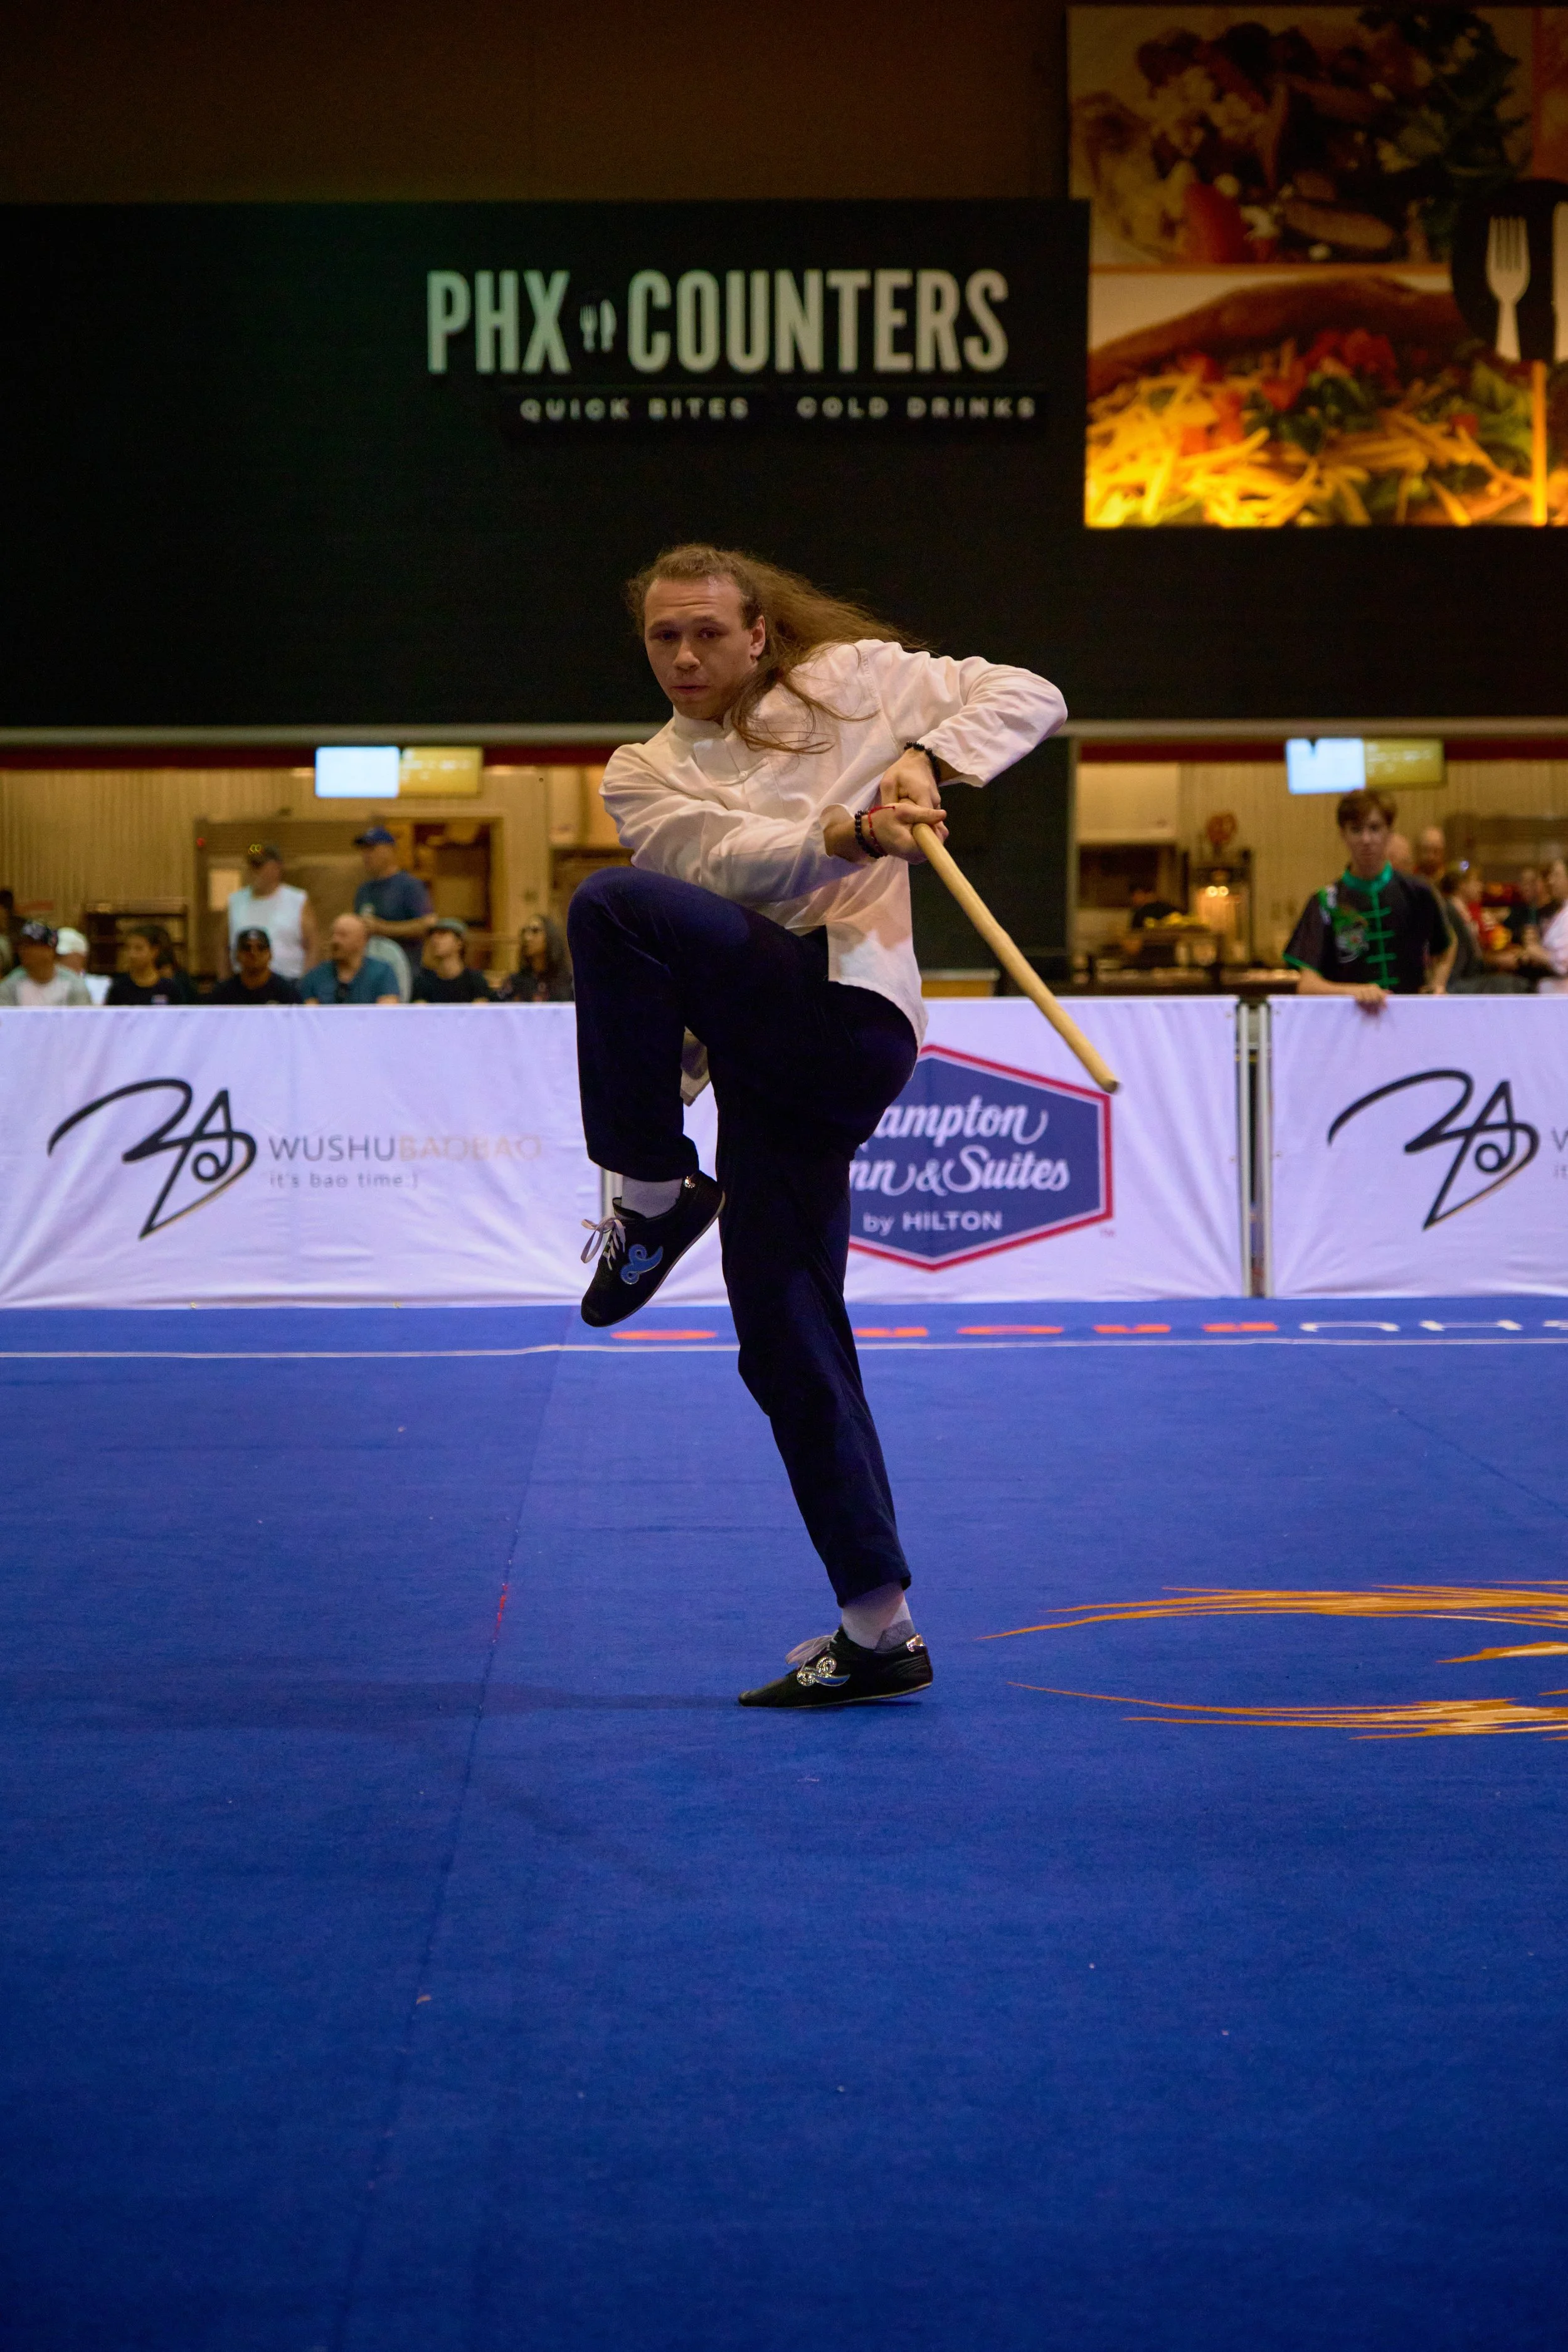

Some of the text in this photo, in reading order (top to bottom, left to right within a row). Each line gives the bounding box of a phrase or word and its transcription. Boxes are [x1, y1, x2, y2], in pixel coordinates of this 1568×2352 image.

[427, 270, 1009, 374] PHX COUNTERS
[519, 396, 1036, 423] QUICK BITES COLD DRINKS
[873, 1094, 1049, 1148] ampton
[309, 1171, 348, 1189] bao
[849, 1158, 916, 1196] nn
[942, 1145, 1070, 1193] Suites
[863, 1210, 1002, 1236] by HILTON
